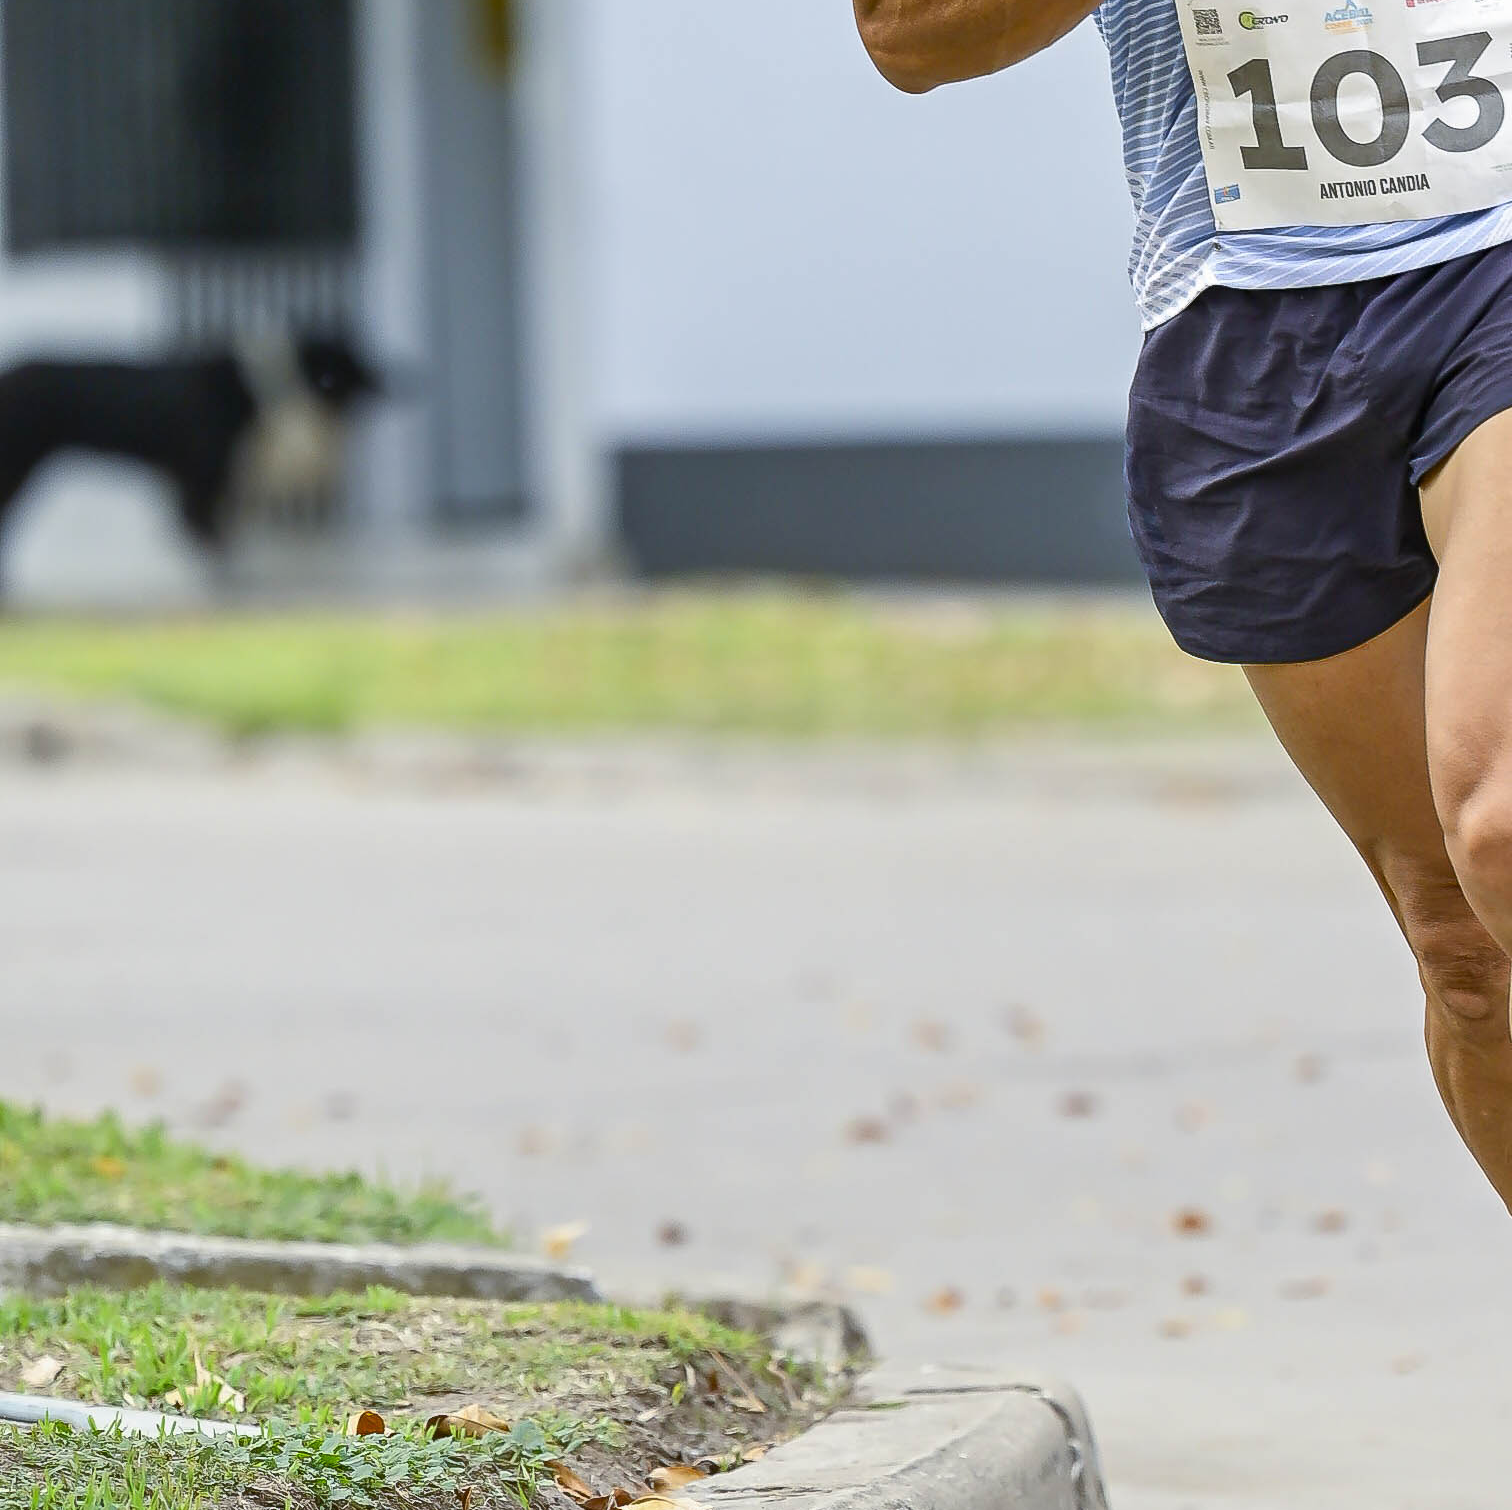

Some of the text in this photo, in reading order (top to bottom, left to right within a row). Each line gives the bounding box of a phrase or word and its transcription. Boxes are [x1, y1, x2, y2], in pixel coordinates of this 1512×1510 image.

[1226, 31, 1505, 172] 103
[1319, 173, 1431, 200] ANTONIO CANDIA
